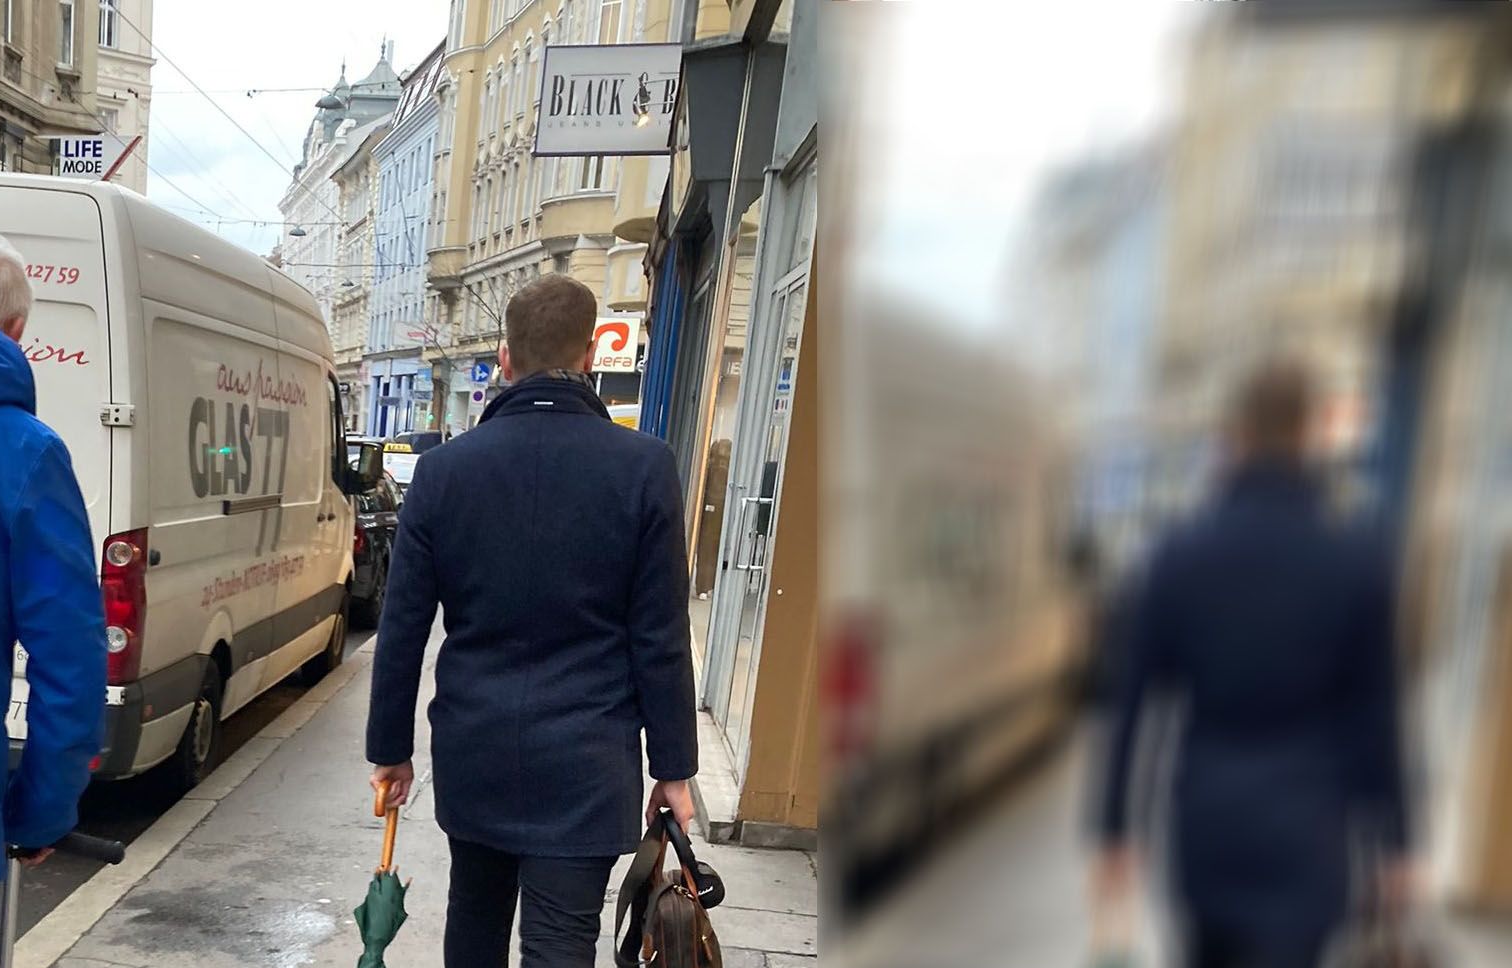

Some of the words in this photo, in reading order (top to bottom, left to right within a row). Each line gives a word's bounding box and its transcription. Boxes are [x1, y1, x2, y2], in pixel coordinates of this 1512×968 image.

[549, 74, 624, 116] BLACK
[64, 140, 102, 158] LIFE
[63, 160, 102, 174] MODE
[56, 267, 80, 285] 59
